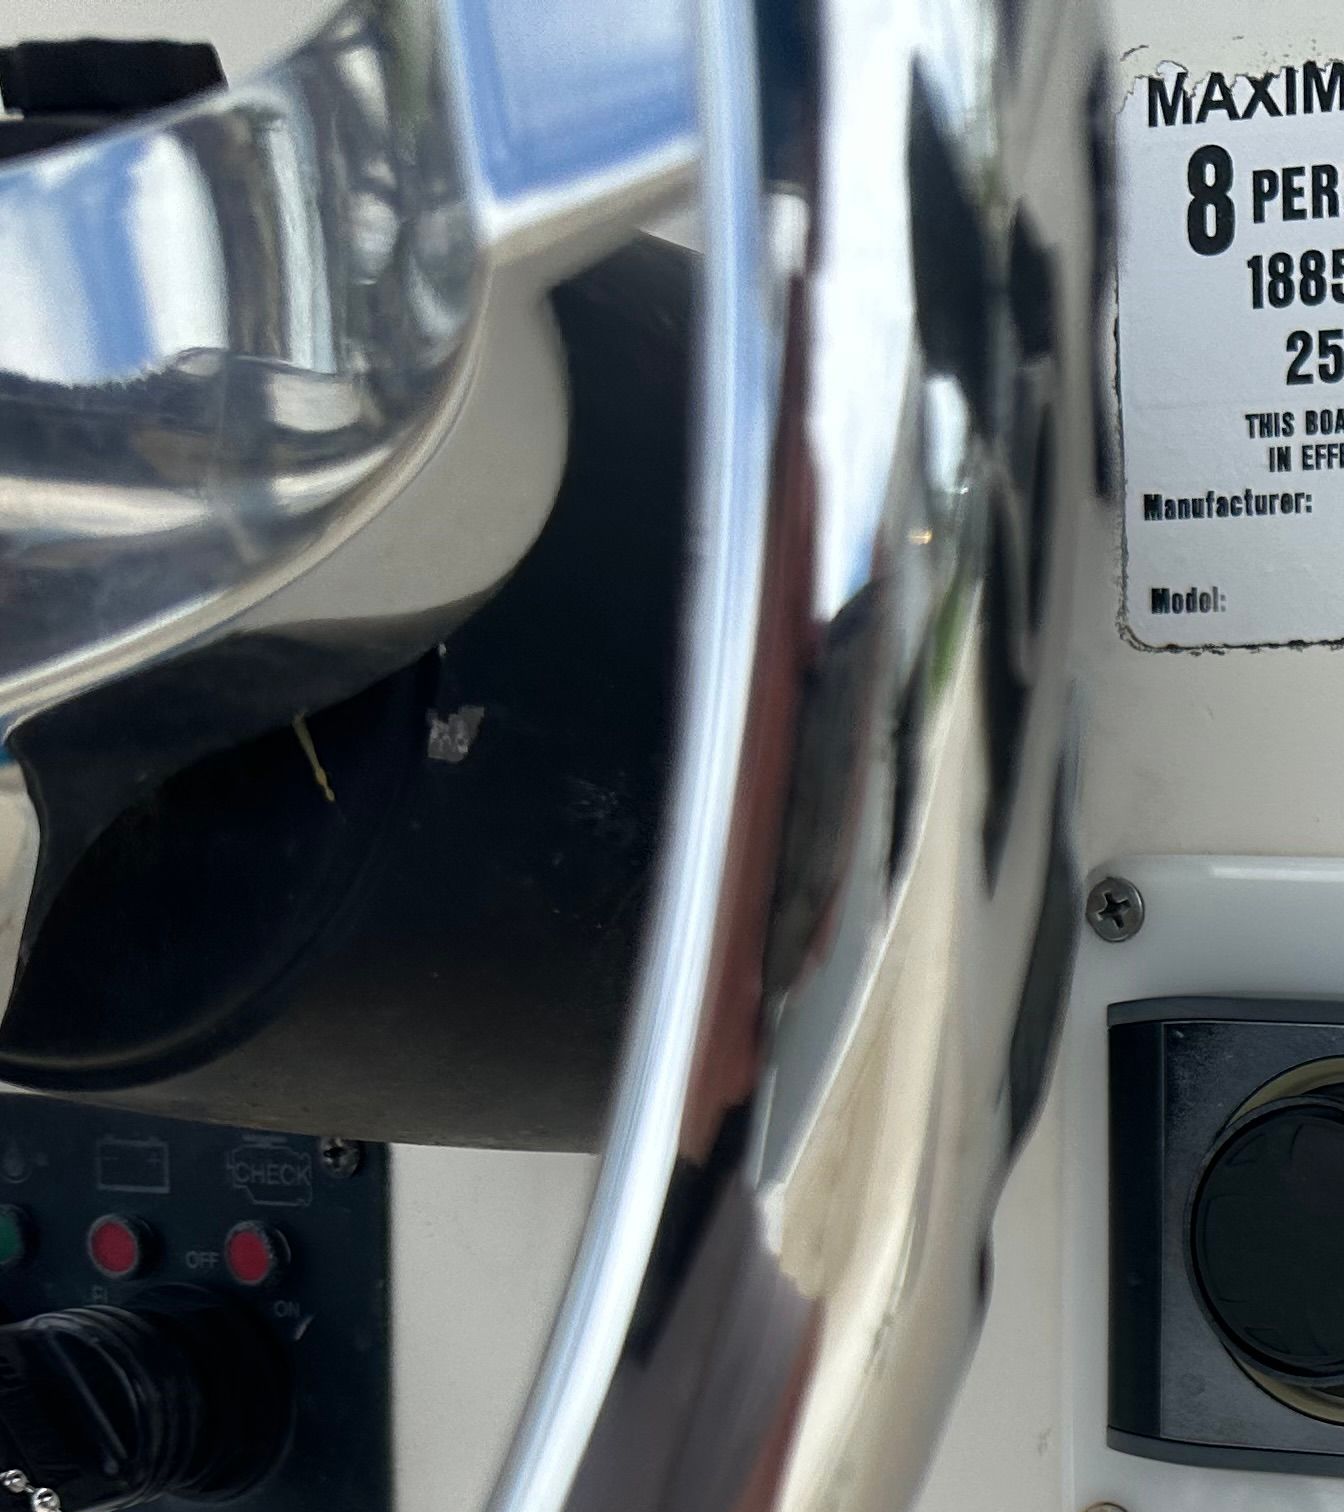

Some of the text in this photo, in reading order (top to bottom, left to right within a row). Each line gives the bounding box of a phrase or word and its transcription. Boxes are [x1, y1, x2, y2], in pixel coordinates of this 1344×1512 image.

[1187, 145, 1235, 256] 8
[1244, 412, 1294, 439] THIS
[1269, 446, 1291, 472] IN
[1143, 488, 1312, 521] Manufacturer:
[1150, 586, 1227, 614] Model:
[233, 1162, 311, 1187] CHECK
[185, 1250, 220, 1270] OFF
